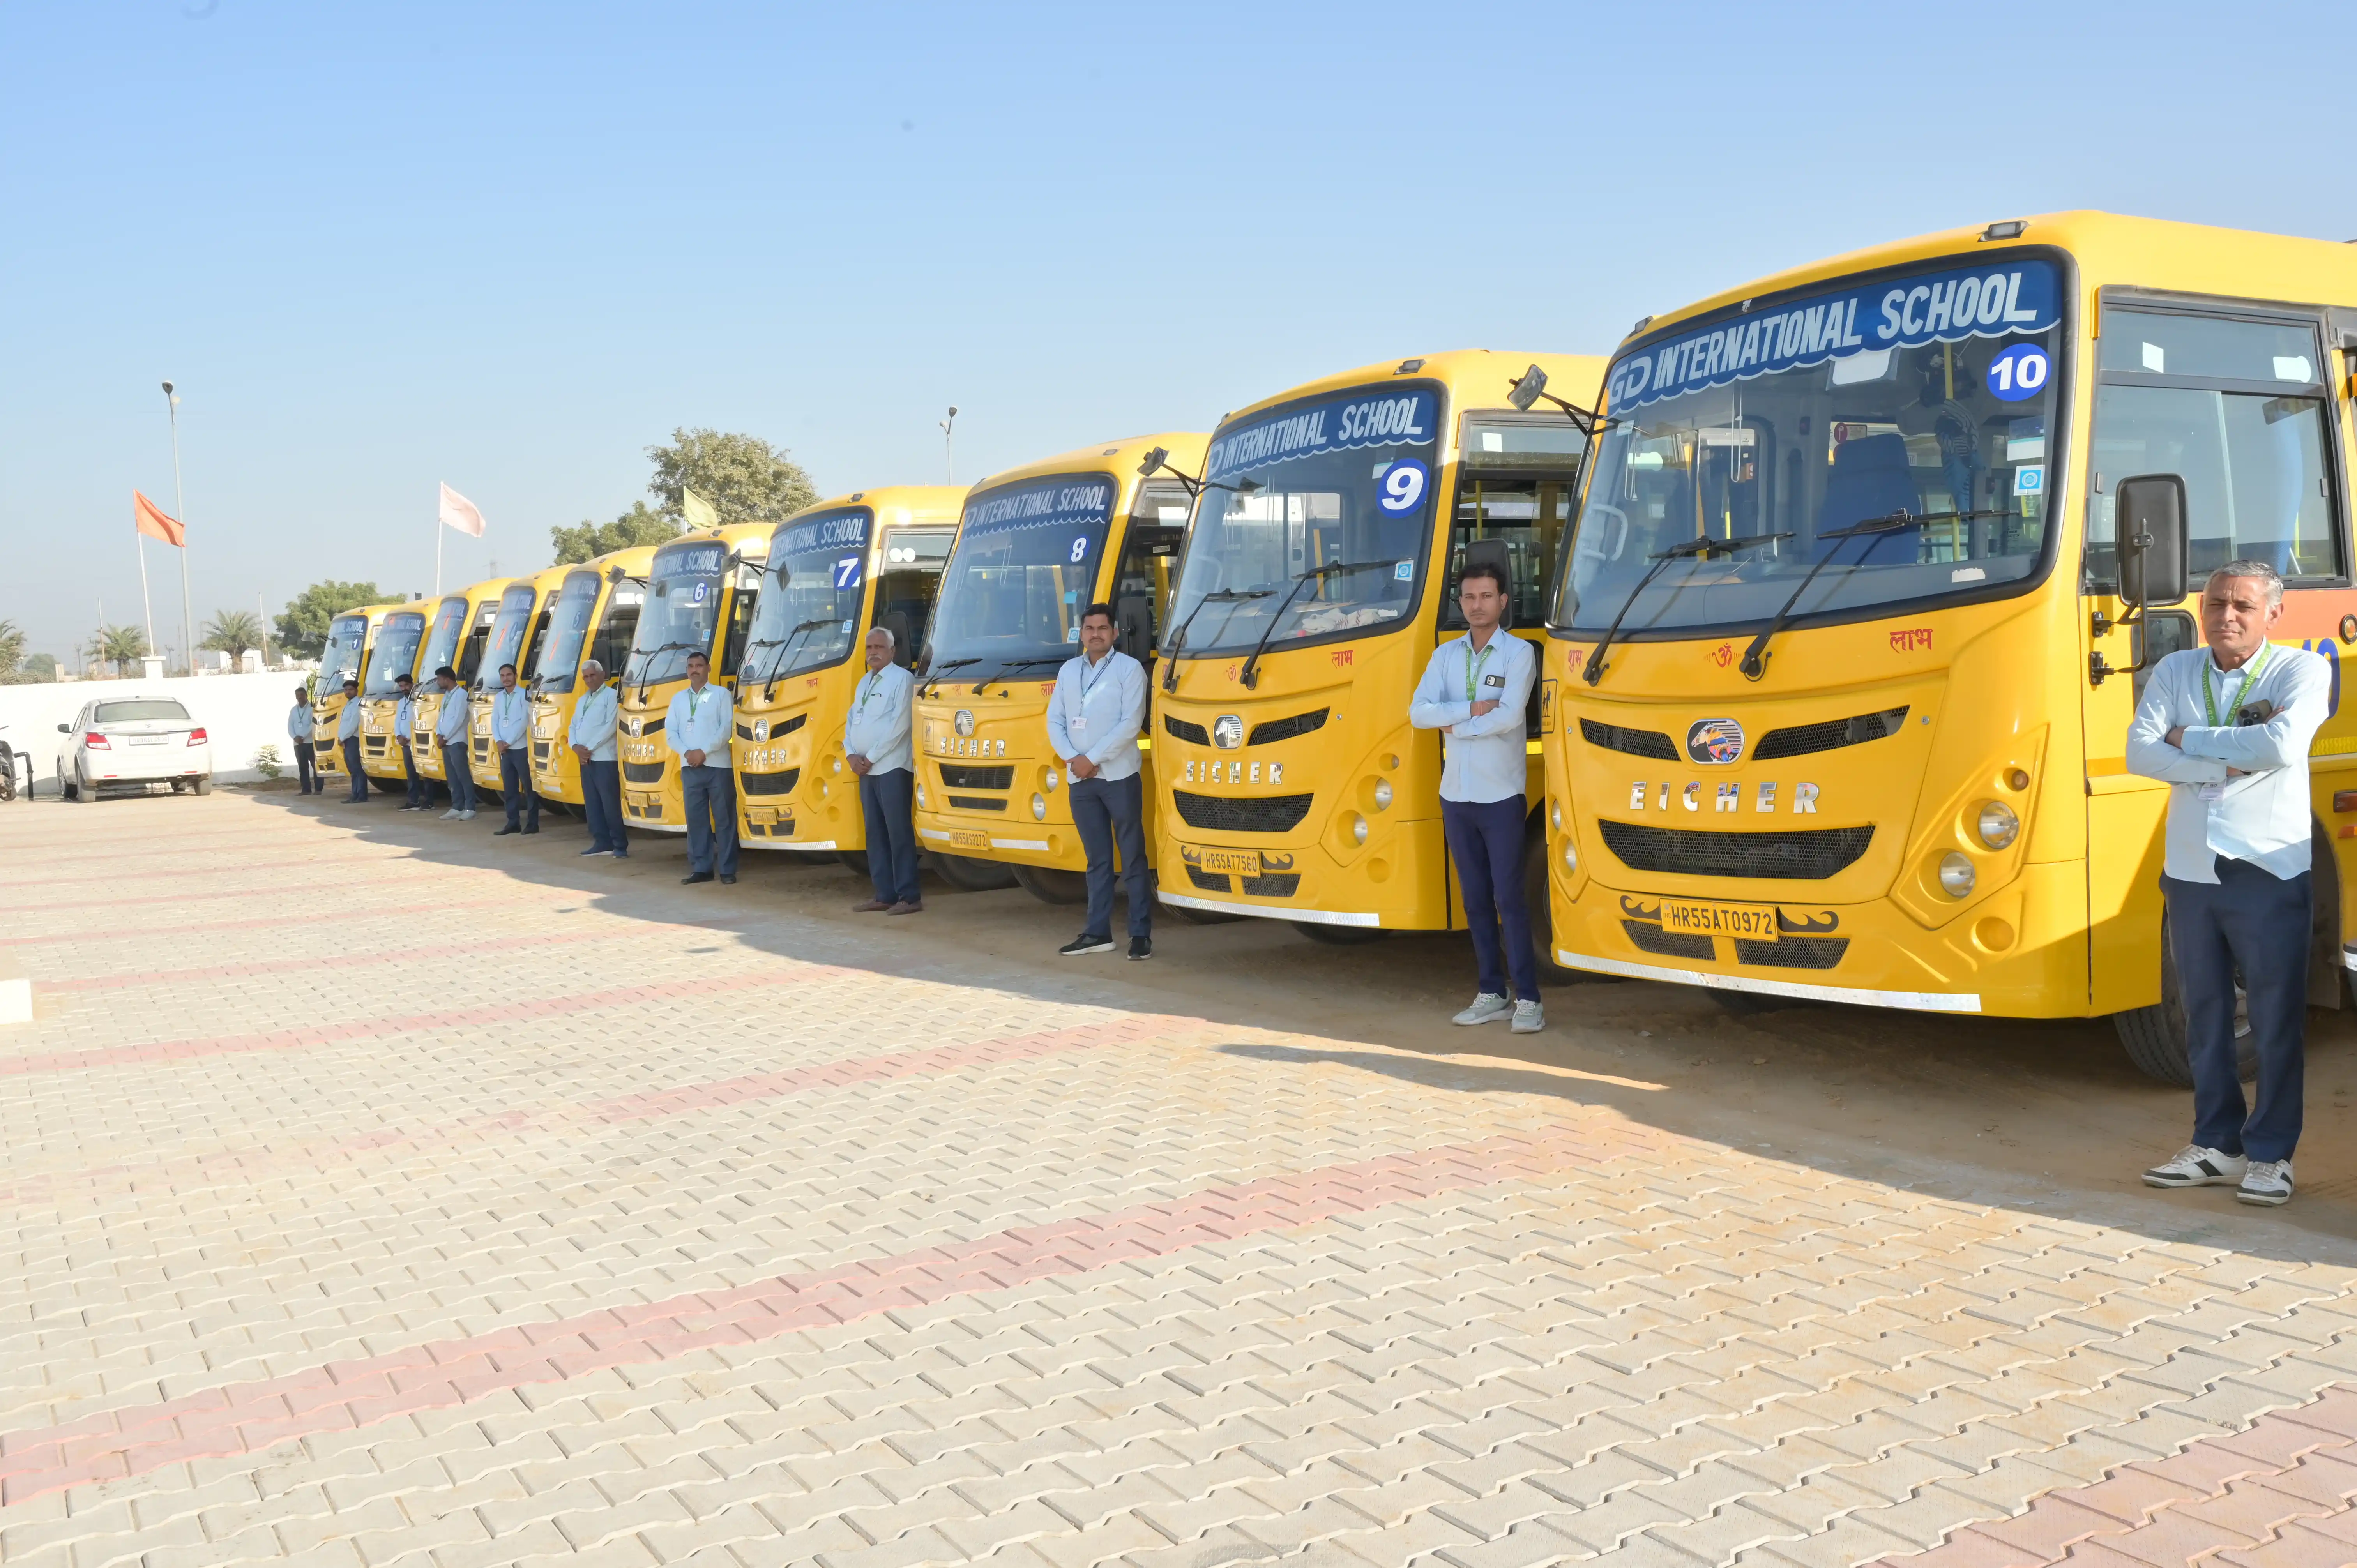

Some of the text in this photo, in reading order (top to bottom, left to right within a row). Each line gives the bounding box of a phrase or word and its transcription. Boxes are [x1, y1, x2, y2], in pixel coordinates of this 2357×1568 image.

[1608, 272, 2037, 406] GD INTERNATIONAL SCHOOL
[1991, 354, 2047, 390] 10
[1209, 397, 1423, 477] D INTERNATIONAL SCHOOL
[1382, 467, 1424, 510] 9
[975, 490, 1056, 527] INTERNATIONAL
[1057, 486, 1105, 512] SCHOOL
[820, 518, 864, 544] SCHOOL
[686, 550, 719, 572] SCHOOL
[1071, 537, 1087, 562] 8
[837, 558, 859, 587] 7
[694, 583, 705, 600] 6
[574, 612, 581, 627] 5
[353, 639, 358, 648] 1
[1889, 628, 1933, 654] लाभ
[1331, 649, 1354, 669] लाभ
[1568, 649, 1583, 673] शुभ
[2233, 665, 2261, 708] INTERNATIONAL
[743, 749, 786, 766] EICHER
[940, 736, 1006, 758] EICHER
[1186, 760, 1283, 785] EICHER
[1629, 780, 1820, 814] EICHER
[952, 832, 987, 847] HR55AS3272
[1206, 852, 1257, 872] HR55AT7560
[1671, 906, 1773, 935] HR55AT0972
